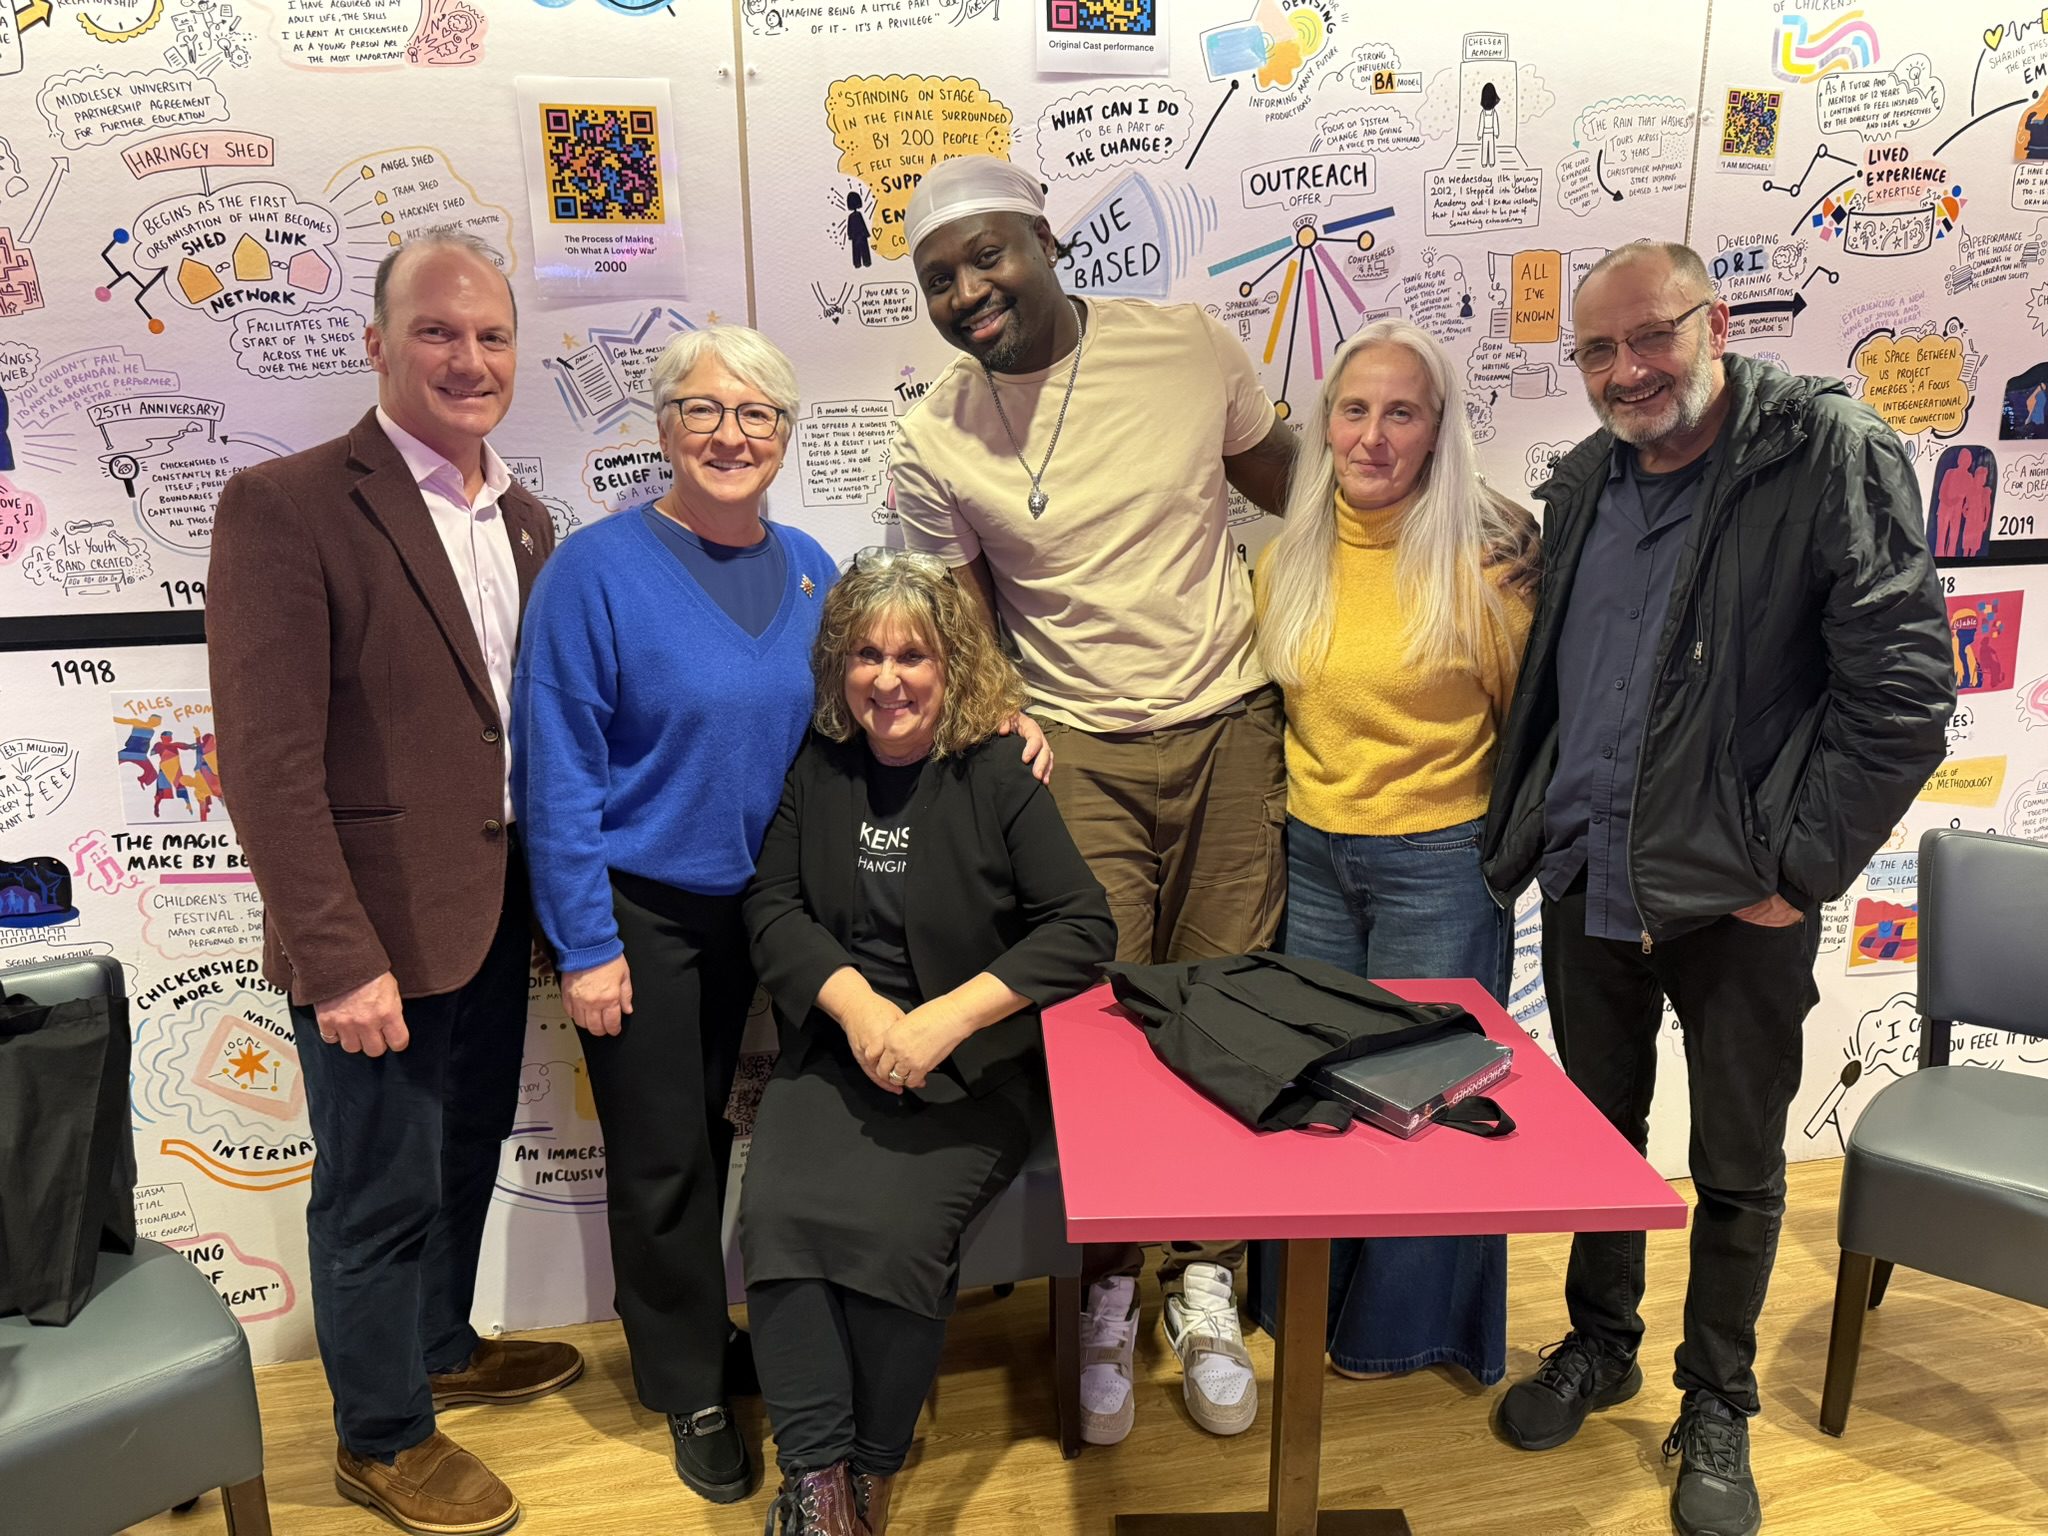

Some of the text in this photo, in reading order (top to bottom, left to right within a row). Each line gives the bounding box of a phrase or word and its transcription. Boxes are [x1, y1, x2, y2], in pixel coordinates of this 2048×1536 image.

[281, 25, 408, 40] I LEARNT AT CHICKENSHED
[1049, 40, 1154, 52] Original Cast performance
[1468, 38, 1502, 46] CHELSEA
[307, 51, 405, 64] THE MOST IMPORTANT
[1357, 51, 1386, 62] STRONG
[1471, 49, 1502, 57] ACADEMY
[1357, 60, 1395, 73] INFLUENCE
[1360, 72, 1419, 90] ON BA MODEL
[55, 81, 192, 109] MIDDLESEX UNIVERSITY
[918, 90, 934, 102] ON
[939, 88, 975, 103] STAGE
[1828, 88, 1900, 107] MENTOR OF 12 YEARS
[74, 96, 210, 123] PARTNERSHIP AGREEMENT
[1051, 98, 1179, 131] WHAT CAN I DO
[74, 110, 205, 140] FOR FURTHER EDUCATION
[843, 109, 1007, 131] IN THE FINALE SURROUNDED
[1588, 115, 1690, 135] THE RAIN THAT WASHES
[872, 129, 978, 150] BY 200 PEOPLE
[1076, 121, 1165, 142] TO BE A PART OF
[128, 141, 268, 172] HARINGEY SHED
[381, 154, 434, 174] ANGEL SHED
[1065, 148, 1095, 167] THE
[1868, 147, 1909, 165] LIVED
[1250, 162, 1367, 196] OUTREACH
[1866, 167, 1946, 187] EXPERIENCE
[1289, 193, 1321, 207] OFFER
[1867, 185, 1921, 204] EXPERTISE
[142, 195, 287, 236] BEGINS AS THE FIRST
[399, 197, 465, 220] HACKNEY SHED
[146, 212, 332, 259] ORGANISATION OF WHAT BECOMES
[181, 228, 307, 256] SHED LINK
[564, 235, 654, 245] The Process of Making
[1717, 234, 1779, 253] DEVELOPING
[611, 246, 638, 256] Lovely
[594, 261, 627, 272] 2000
[1075, 242, 1160, 289] BASED
[1521, 263, 1548, 281] ALL
[1728, 275, 1771, 288] TRAINING
[209, 290, 296, 314] NETWORK
[865, 290, 878, 298] YOU
[880, 288, 898, 296] CARE
[1524, 287, 1544, 301] I'VE
[1731, 287, 1794, 301] ORGANISATIONS
[246, 316, 349, 334] FACILITATES THE
[1515, 308, 1555, 324] KNOWN
[242, 332, 355, 348] START OF 14 SHEDS
[1482, 342, 1503, 352] BORN
[1476, 350, 1522, 361] OUT OF NEW
[1860, 347, 1956, 367] THE SPACE BETWEEN
[1482, 362, 1510, 371] WRITING
[1879, 366, 1931, 384] US PROJECT
[1870, 384, 1908, 396] EMERGES
[1917, 380, 1924, 392] A
[93, 401, 219, 421] 25TH ANNIVERSARY
[1909, 412, 1955, 424] CONNECTION
[593, 468, 651, 494] BELIEF
[1998, 515, 2034, 536] 2019
[58, 534, 117, 556] 1st Youth
[55, 556, 133, 574] BAND CREATED
[51, 660, 115, 686] 1998
[123, 696, 173, 716] TALES
[26, 743, 64, 754] MILLION
[1936, 776, 1993, 790] METHODOLOGY
[111, 833, 229, 852] THE MAGIC
[127, 854, 215, 871] MAKE BY
[1880, 860, 1896, 870] THE
[1870, 877, 1881, 886] OF
[174, 910, 234, 925] FESTIVAL
[137, 959, 259, 1010] CHICKENSHED
[173, 981, 223, 1010] MORE
[224, 1036, 261, 1057] LOCAL
[1971, 1033, 1998, 1050] FEEL
